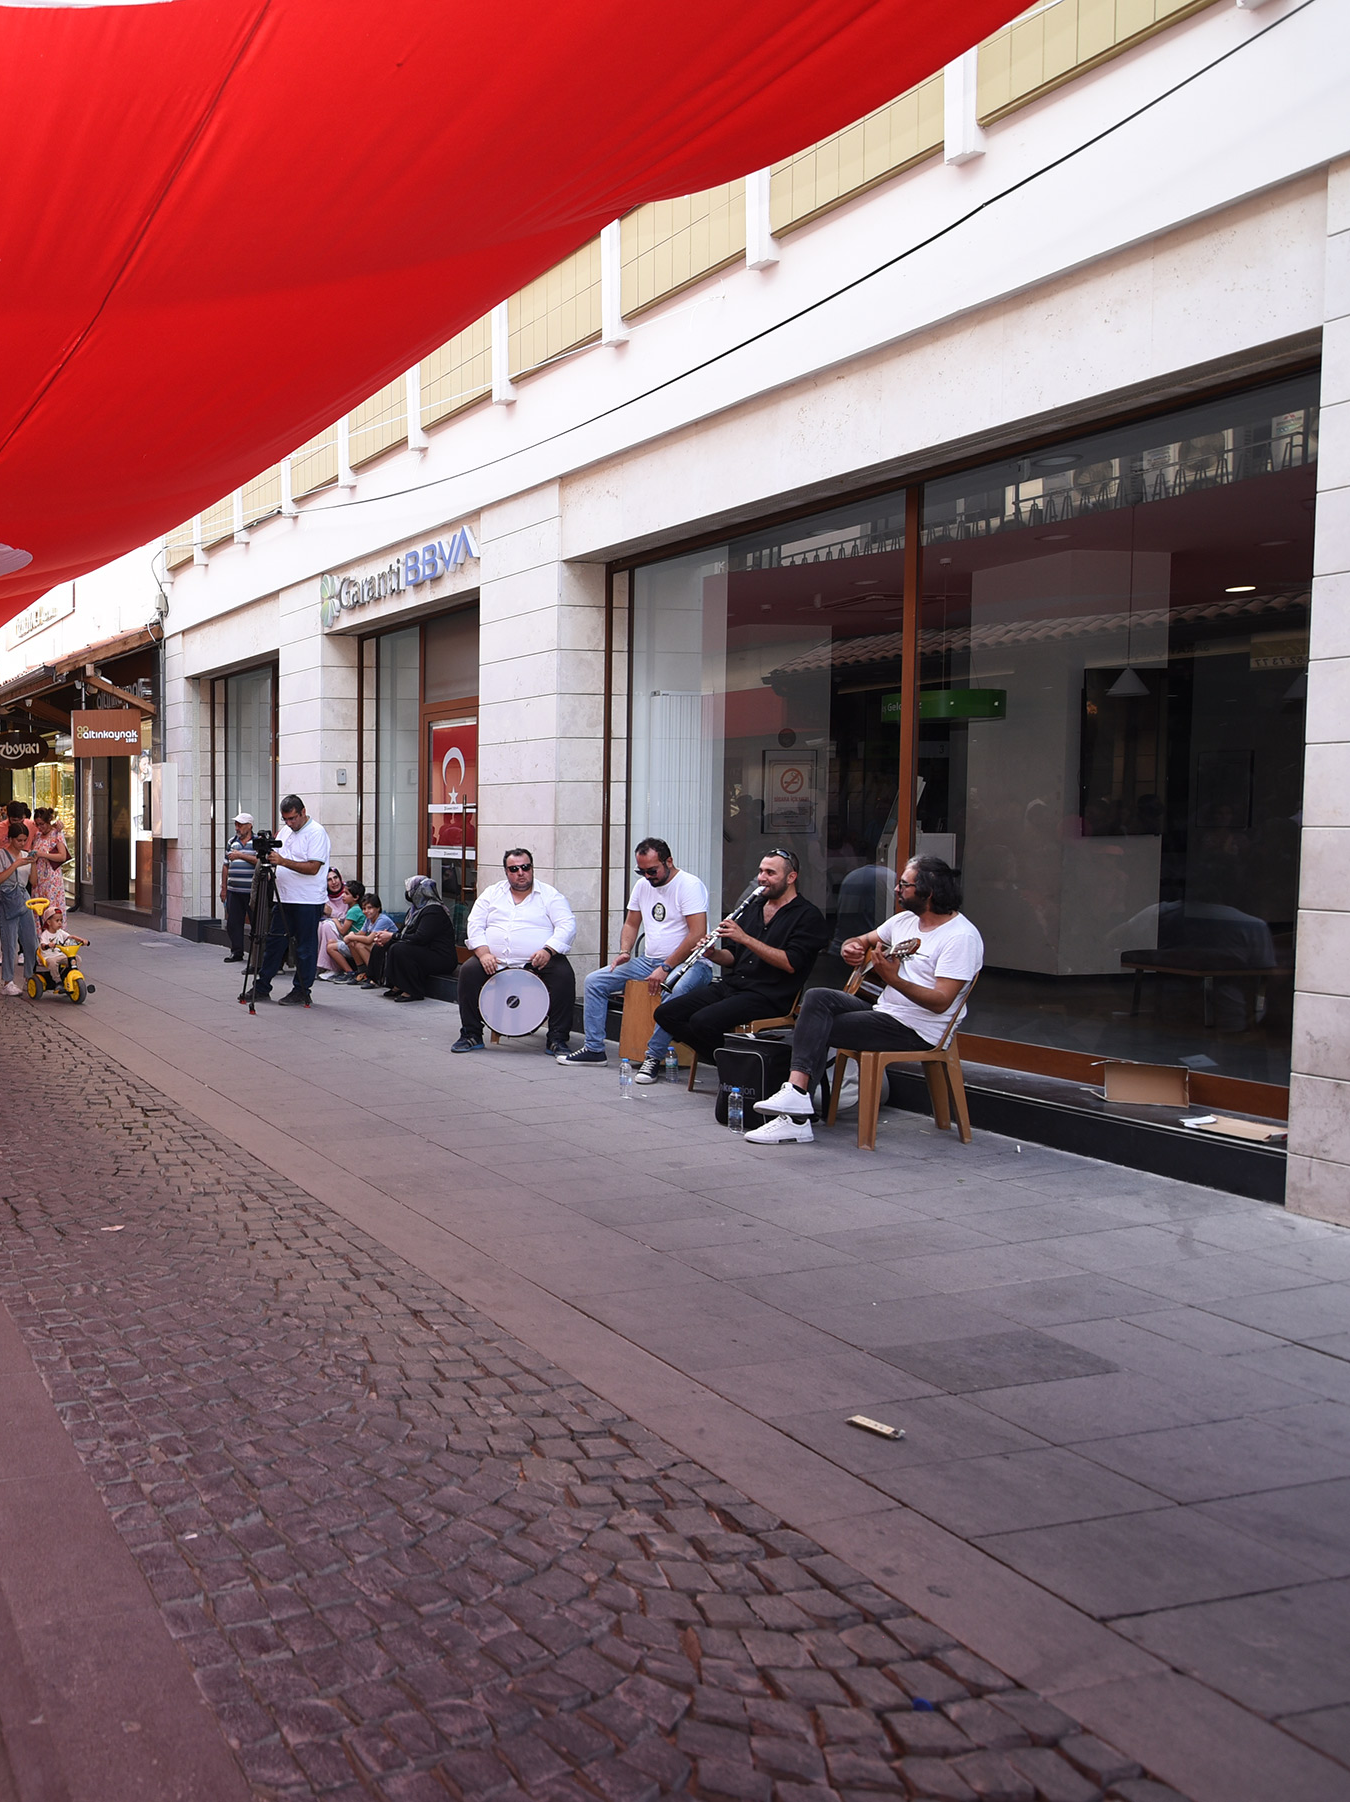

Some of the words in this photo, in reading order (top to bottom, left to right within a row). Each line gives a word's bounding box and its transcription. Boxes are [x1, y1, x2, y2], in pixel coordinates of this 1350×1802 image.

[339, 558, 404, 610] Garanti
[405, 525, 479, 586] BBVA
[82, 729, 138, 741] altınkaynak
